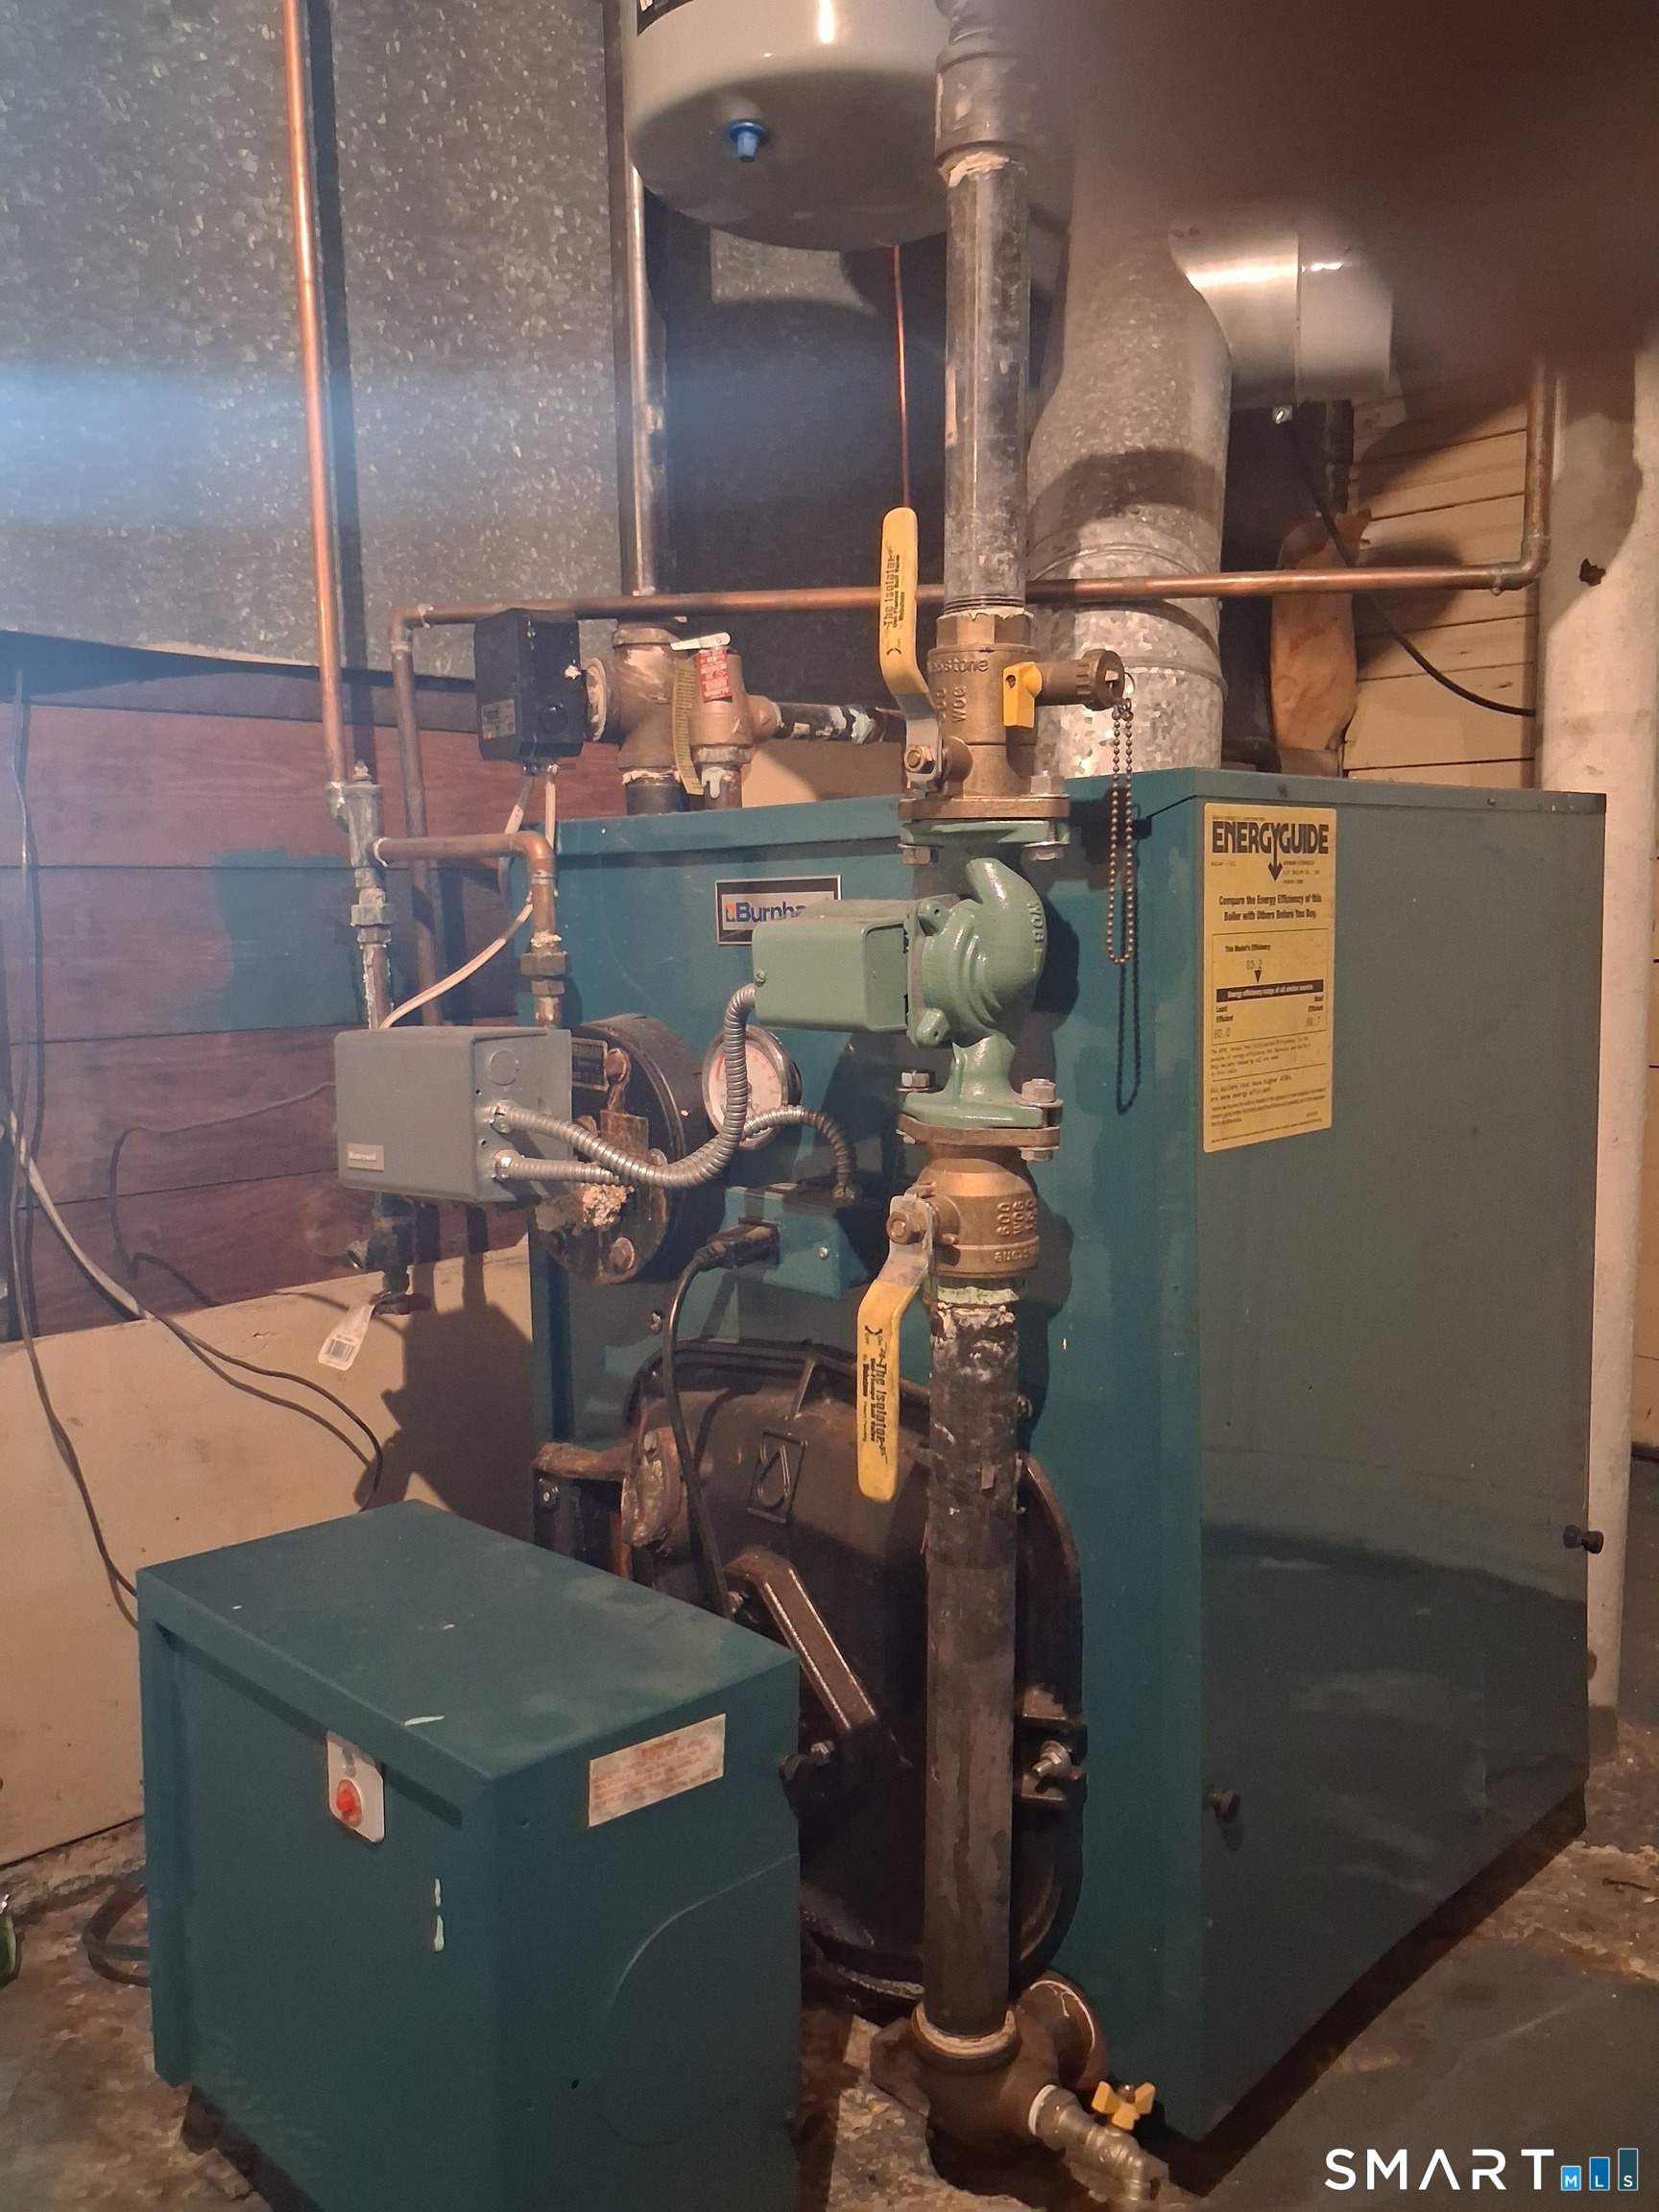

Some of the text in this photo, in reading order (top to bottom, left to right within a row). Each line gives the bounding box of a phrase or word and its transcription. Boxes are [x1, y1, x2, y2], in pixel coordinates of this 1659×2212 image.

[1212, 821, 1329, 854] ENERGYGUIDE
[876, 1362, 888, 1444] The Isolator
